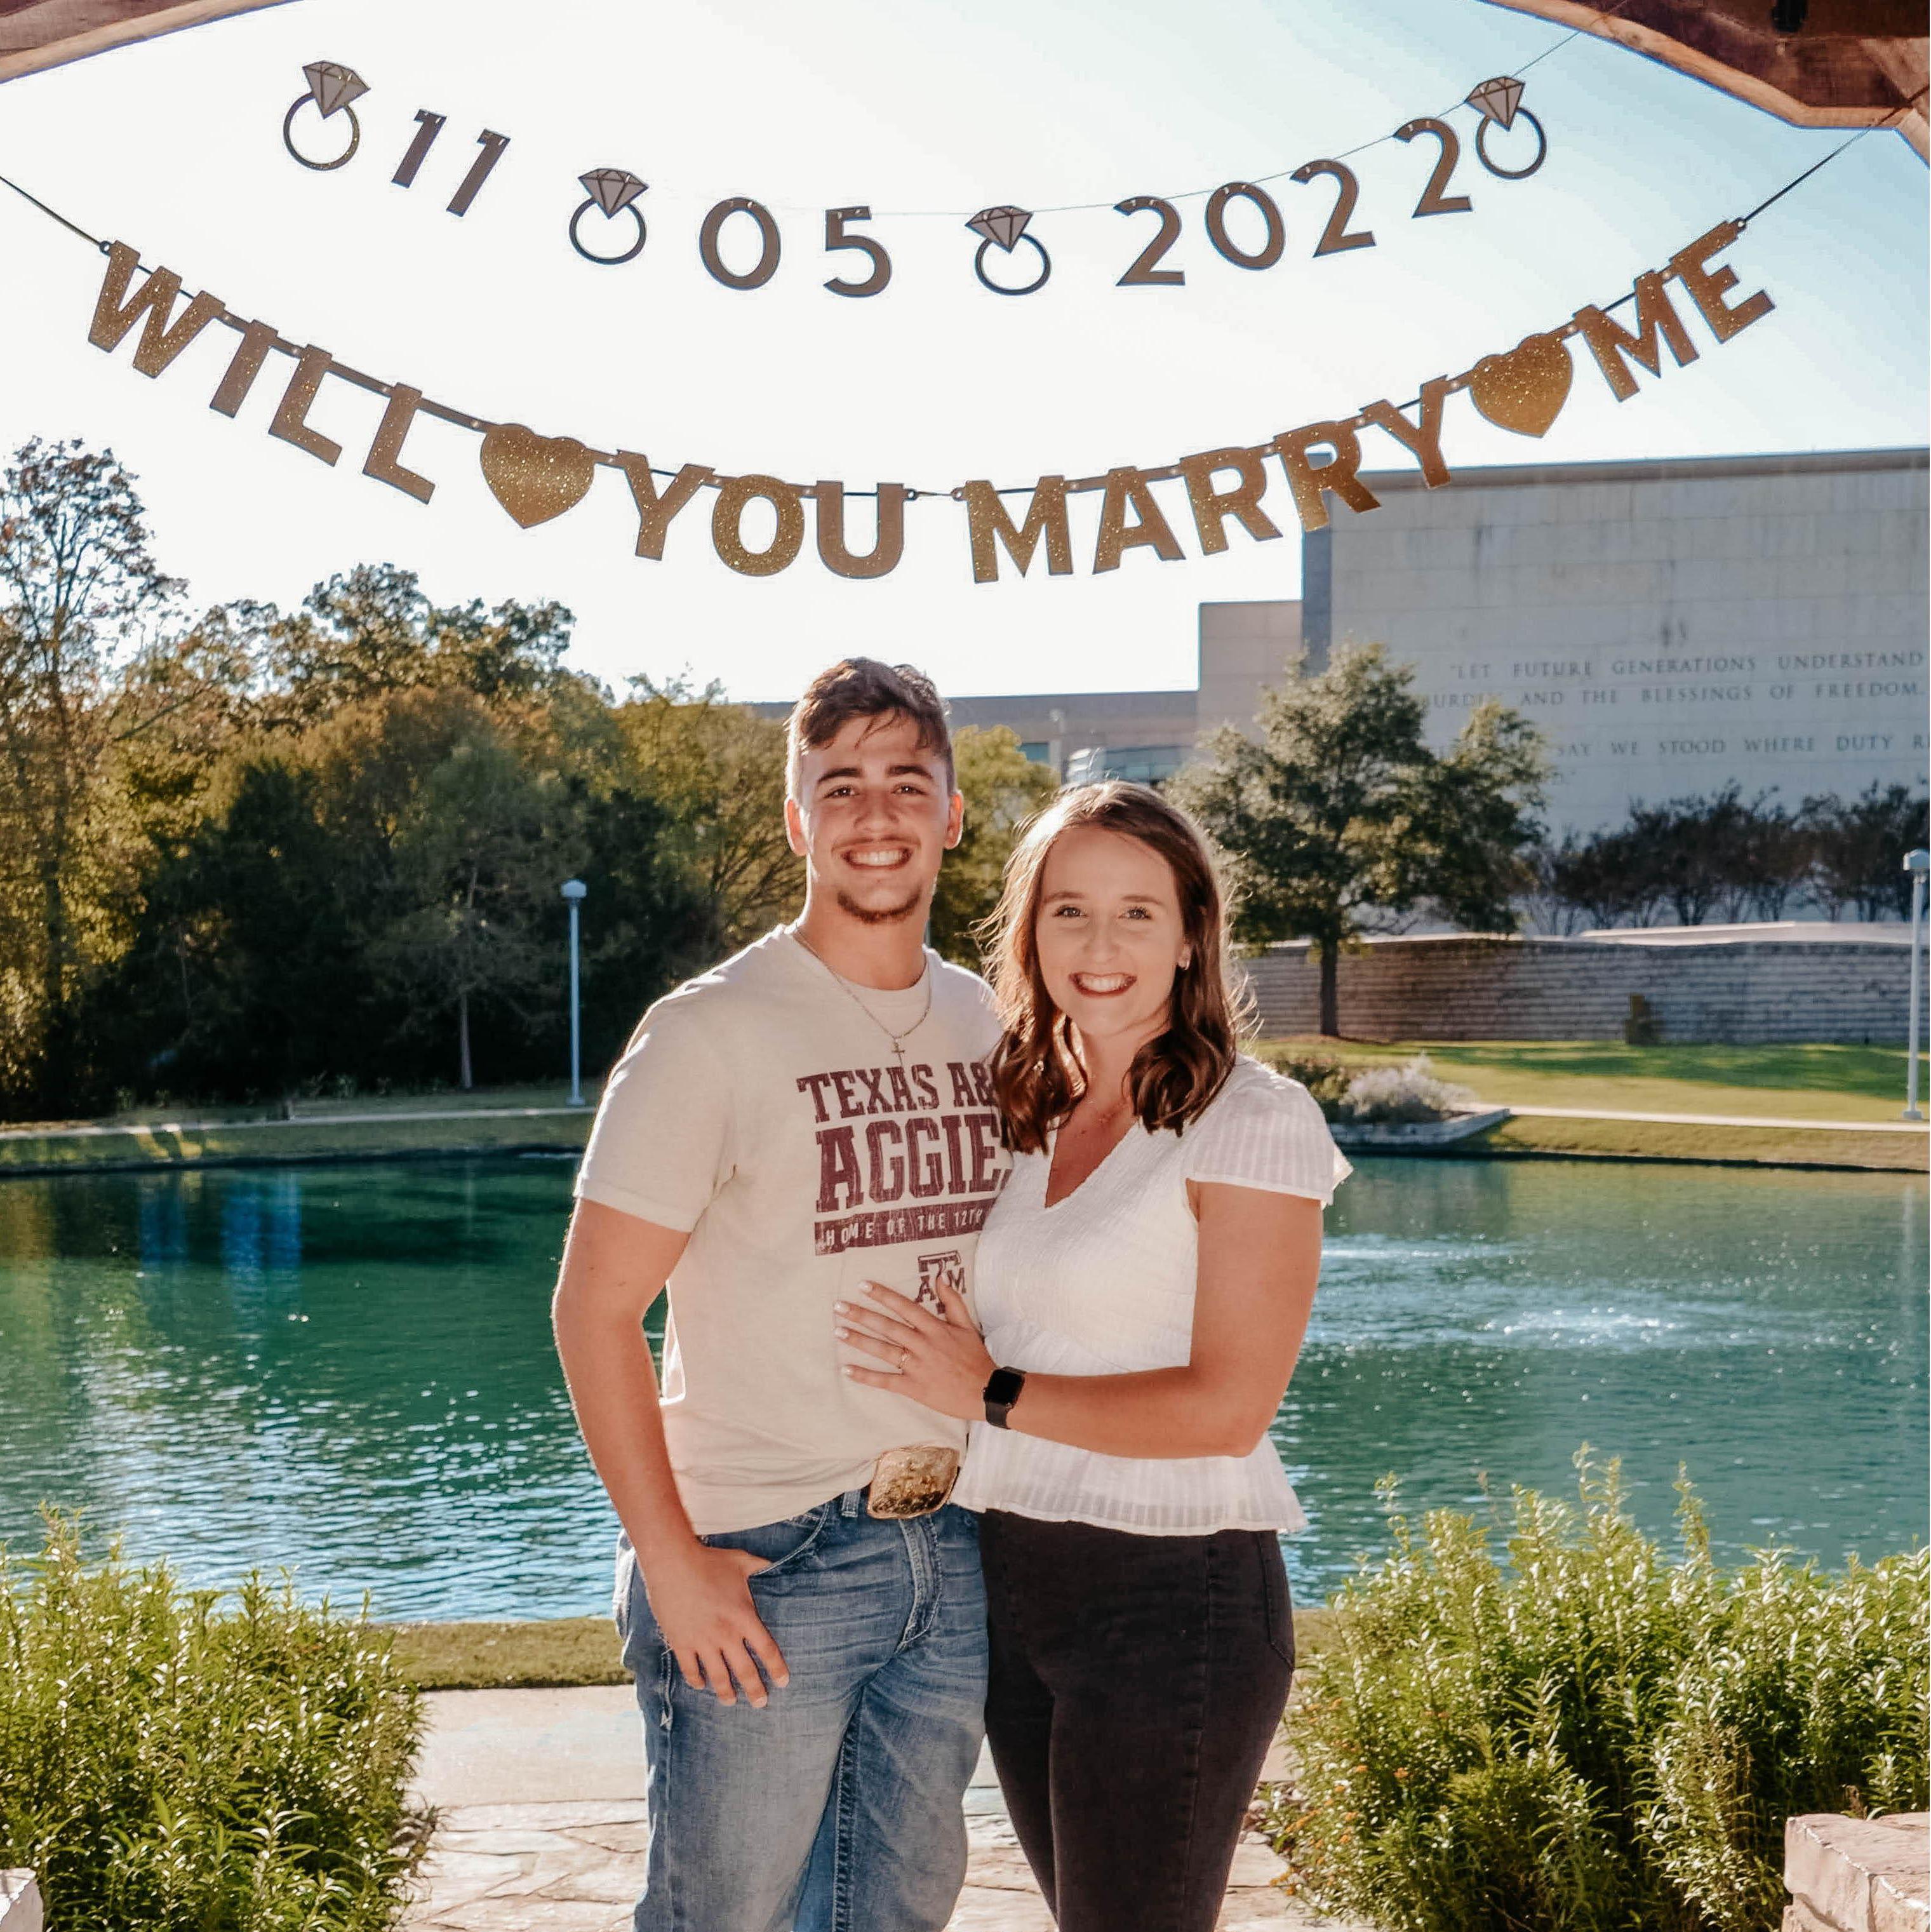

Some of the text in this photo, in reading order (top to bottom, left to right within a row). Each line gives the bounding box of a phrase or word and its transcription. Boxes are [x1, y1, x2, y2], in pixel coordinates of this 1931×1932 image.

[391, 107, 1474, 298] 11 05 2022
[88, 220, 1775, 584] WILL YOU MARRY ME
[1513, 659, 1592, 678] FUTURE
[1611, 655, 1756, 675] GENERATIONS
[1777, 650, 1924, 670] UNDERSTAND
[1520, 690, 1564, 707] AND
[1582, 688, 1619, 705] THE
[1641, 684, 1753, 702] BLESSINGS
[1769, 682, 1795, 700] OF
[1610, 741, 1640, 757] WE
[1659, 737, 1727, 756] STOOD
[1744, 734, 1816, 754] WHERE
[1836, 733, 1894, 752] DUTY
[796, 1062, 999, 1123] TEXAS A&
[815, 1113, 1012, 1213] AGGIE
[825, 1222, 874, 1246] HOME
[886, 1218, 905, 1236] OF
[918, 1212, 946, 1232] THE
